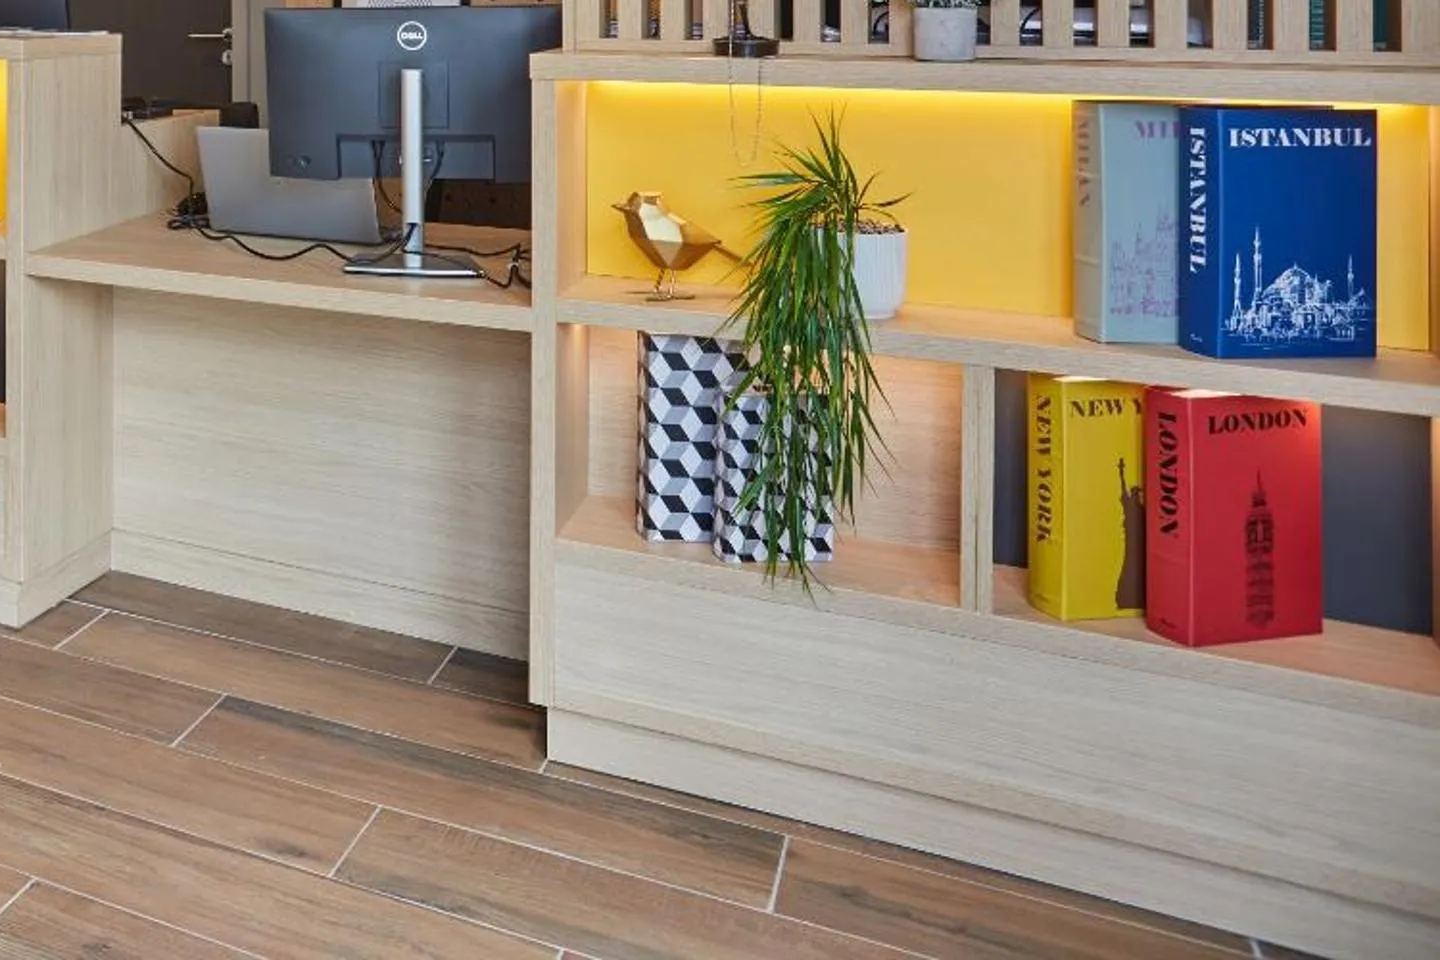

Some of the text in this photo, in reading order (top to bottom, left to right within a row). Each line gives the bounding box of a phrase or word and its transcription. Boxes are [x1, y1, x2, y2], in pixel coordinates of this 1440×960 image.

[1078, 120, 1091, 207] MILAN
[1229, 127, 1372, 148] ISTANBUL
[1189, 127, 1207, 274] ISTANBUL
[1070, 398, 1124, 417] NEW
[1209, 409, 1308, 434] LONDON
[1037, 394, 1052, 542] NEW YORK
[1158, 411, 1179, 538] LONDON
